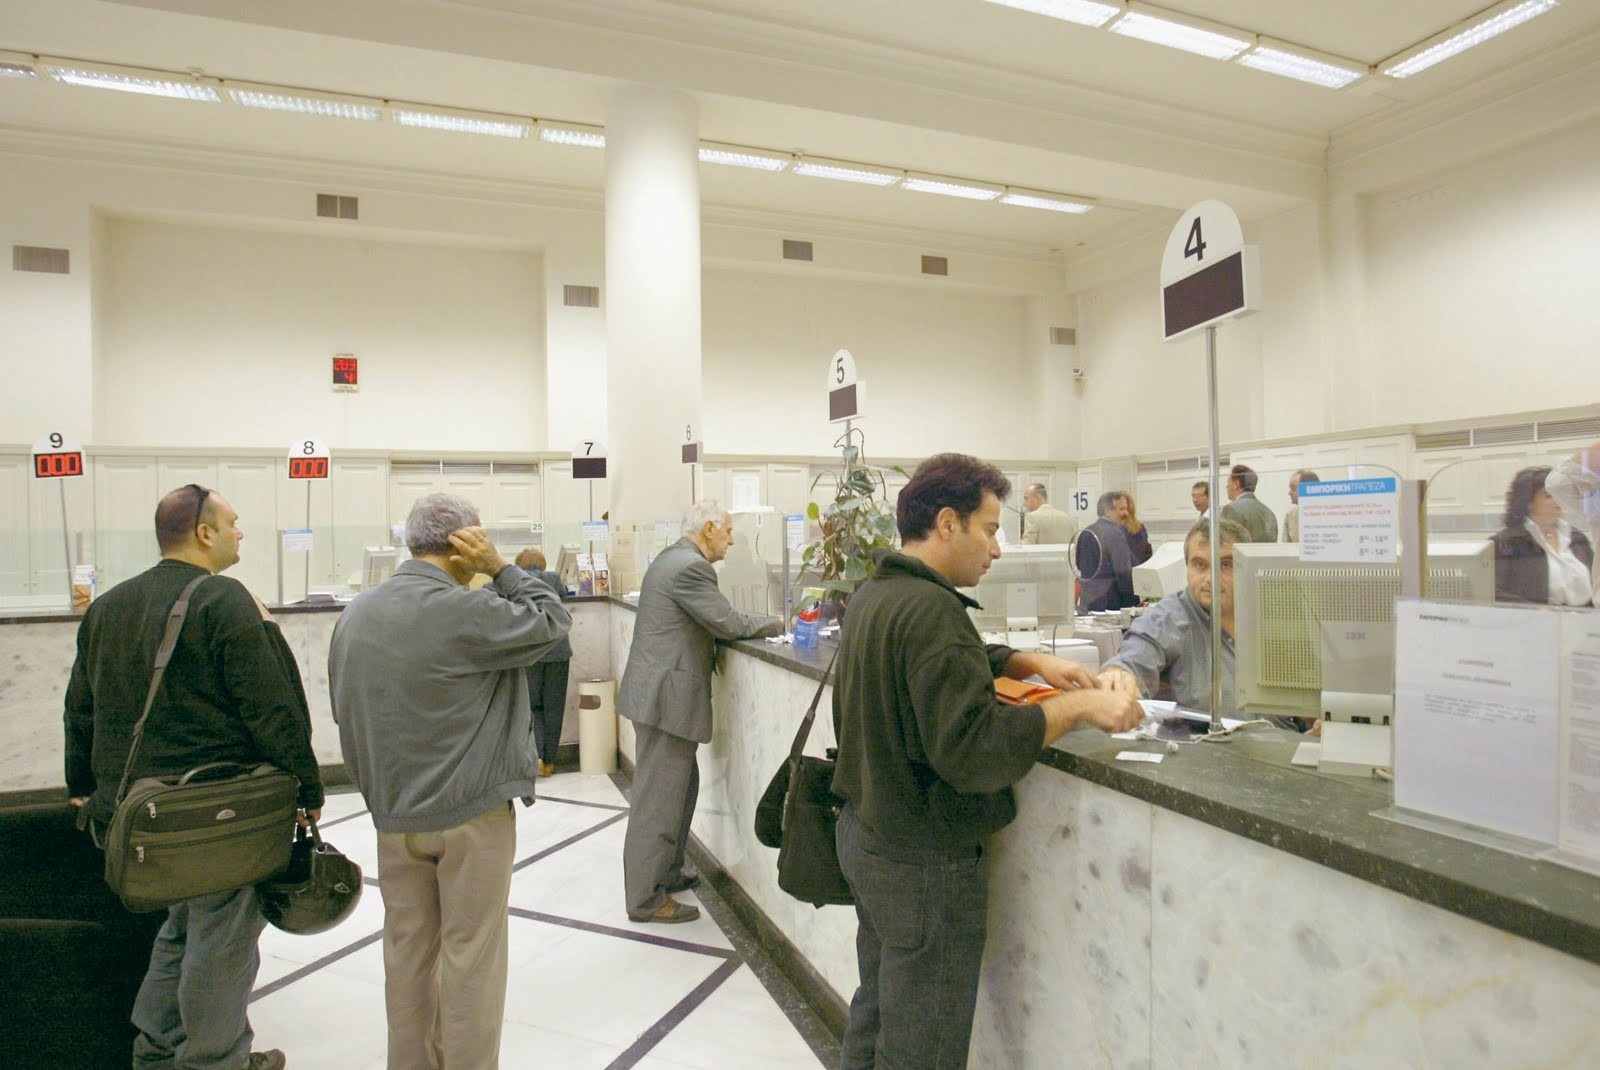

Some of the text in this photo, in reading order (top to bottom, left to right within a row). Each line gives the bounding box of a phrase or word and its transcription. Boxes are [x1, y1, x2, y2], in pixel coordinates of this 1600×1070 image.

[1184, 216, 1206, 261] 4
[837, 357, 845, 384] 5
[49, 432, 63, 449] 9
[686, 424, 691, 441] 6
[303, 440, 315, 455] 8
[584, 442, 594, 456] 7
[37, 453, 80, 476] 000
[291, 459, 327, 477] 000
[1073, 491, 1088, 511] 15
[532, 523, 543, 531] 25
